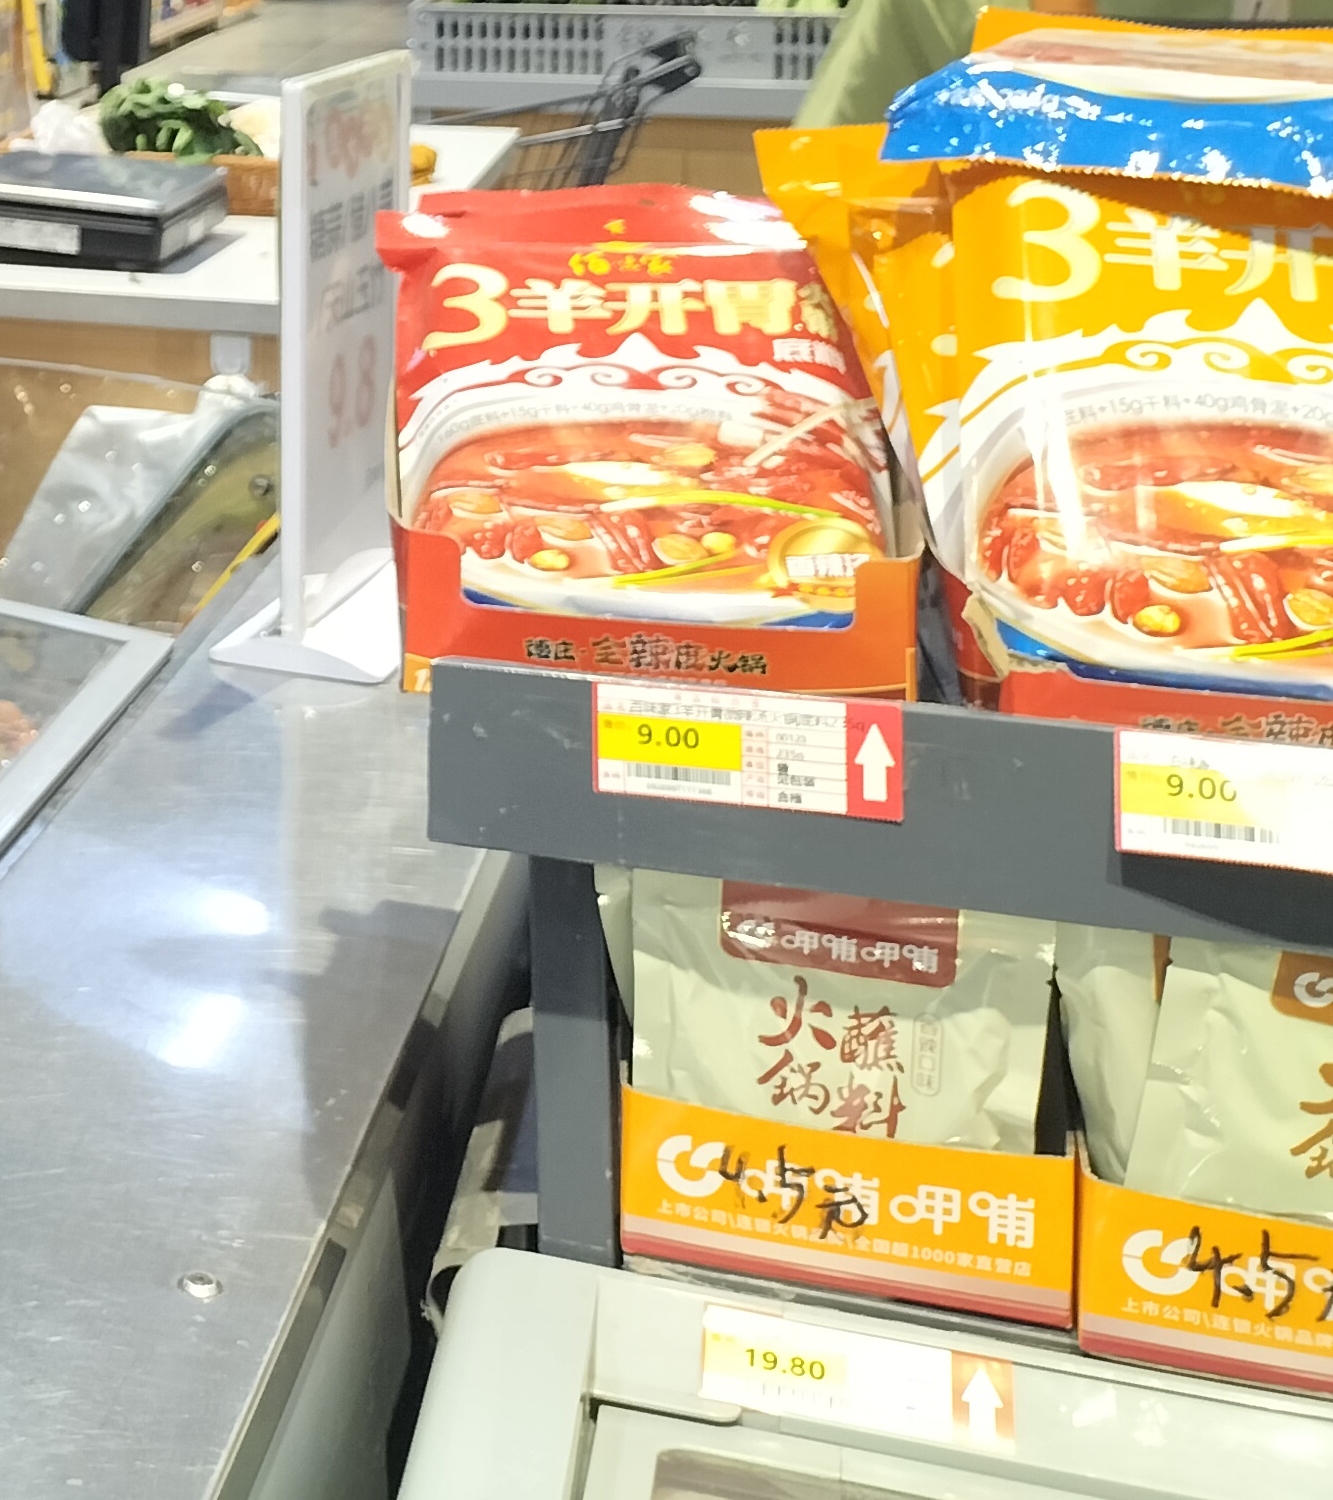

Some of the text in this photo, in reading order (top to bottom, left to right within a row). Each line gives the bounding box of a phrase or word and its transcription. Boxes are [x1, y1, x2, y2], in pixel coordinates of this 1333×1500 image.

[637, 723, 700, 749] 9.00
[1166, 773, 1237, 802] 9.00
[781, 929, 939, 974] 呷哺呷哺
[756, 975, 837, 1116] 火锅
[831, 1004, 907, 1139] 蘸料
[744, 1347, 826, 1382] 19.80
